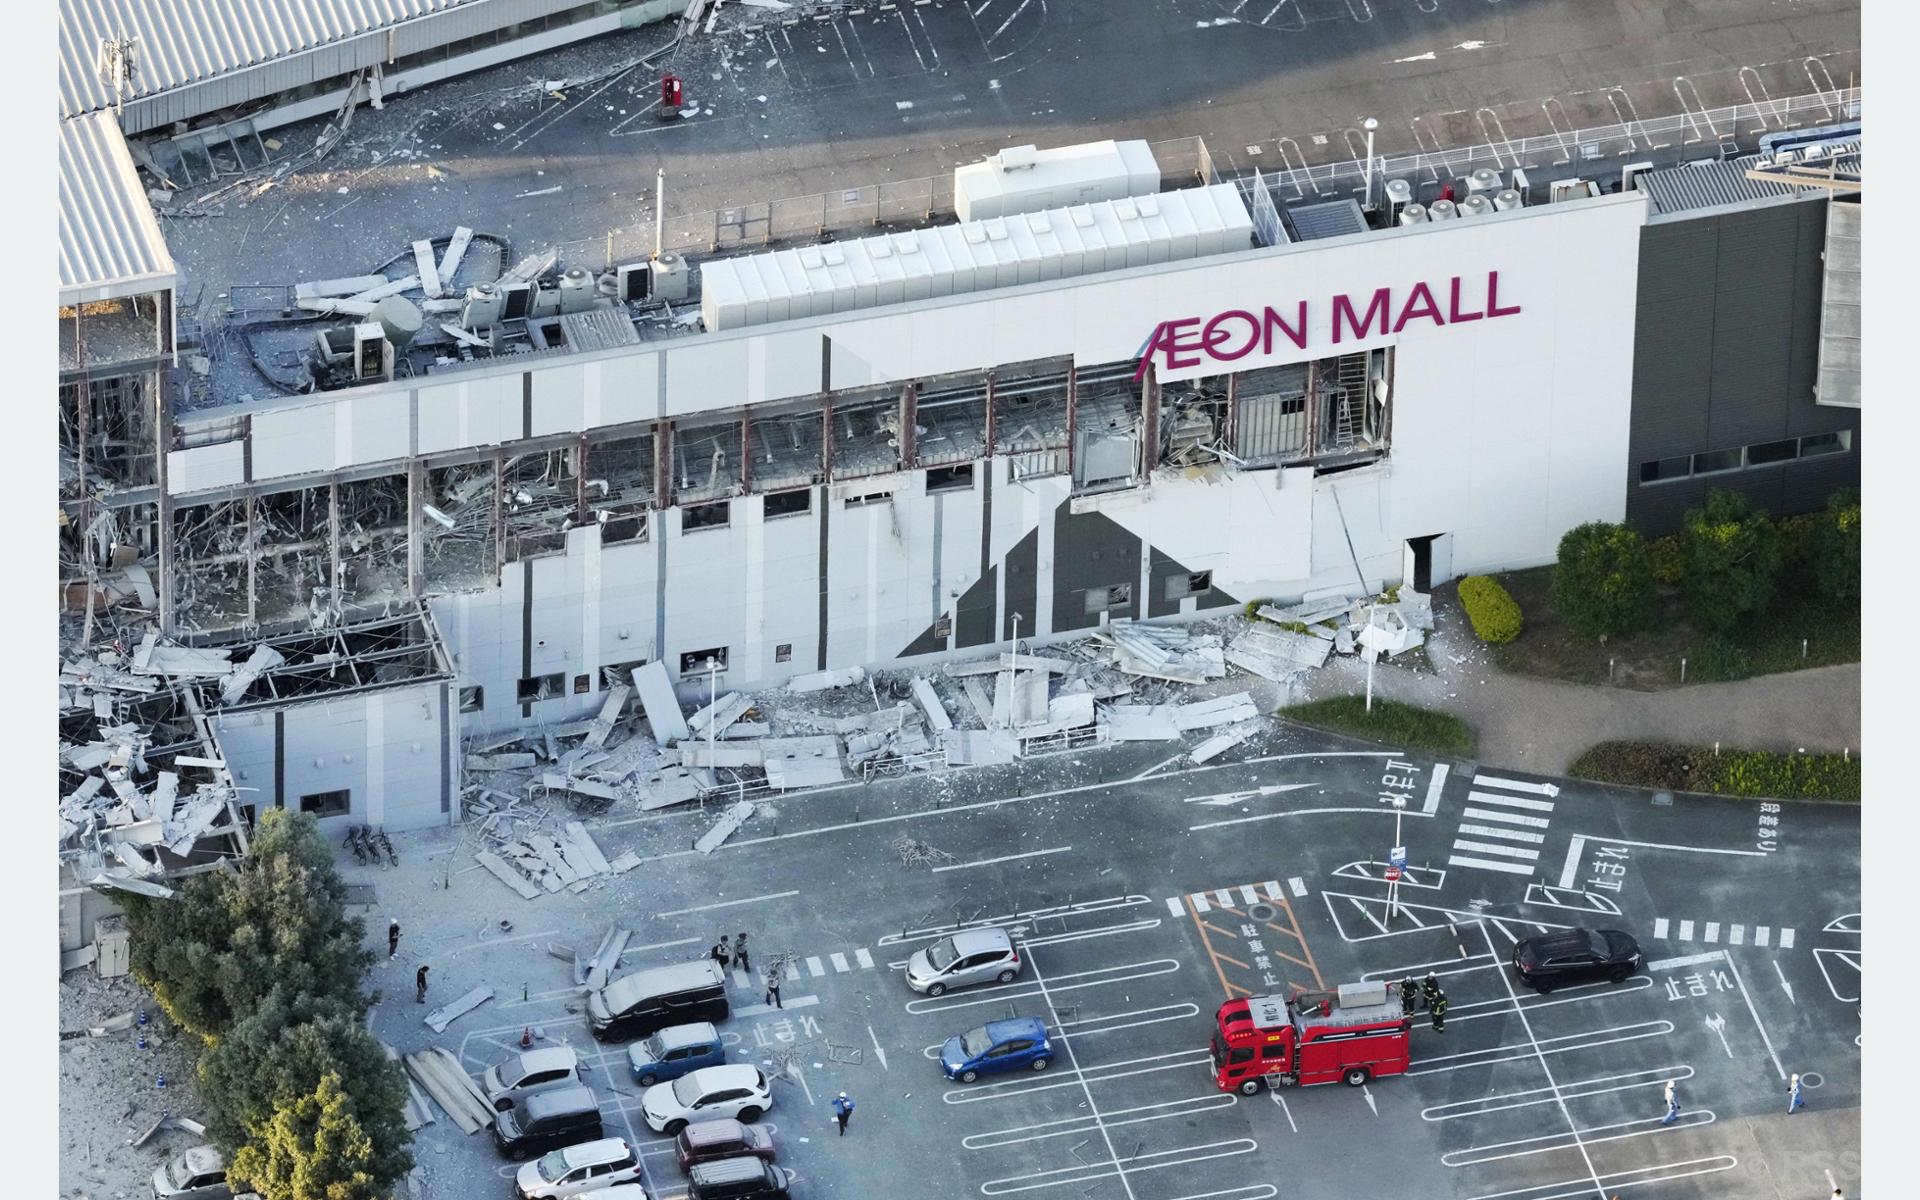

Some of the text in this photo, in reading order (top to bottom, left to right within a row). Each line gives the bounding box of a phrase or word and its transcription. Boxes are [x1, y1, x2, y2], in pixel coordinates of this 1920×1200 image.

[1331, 270, 1521, 345] MALL
[1587, 846, 1630, 893] 止まれ
[1240, 923, 1280, 987] 駐車禁止
[1664, 969, 1735, 1001] 止まれ
[752, 1015, 823, 1047] 止まれ
